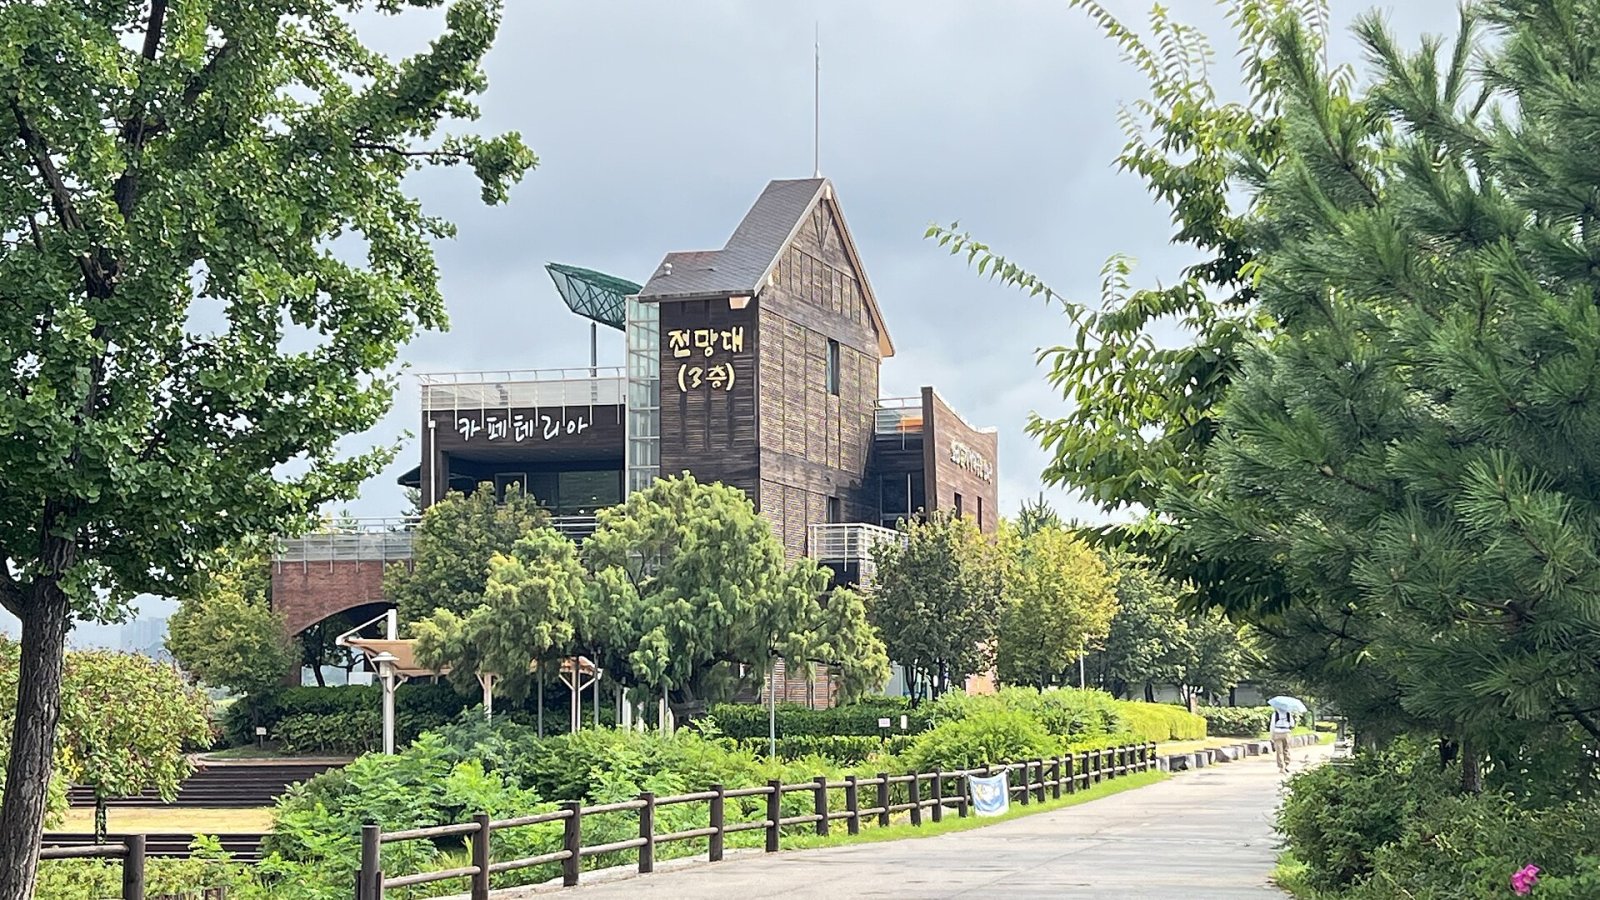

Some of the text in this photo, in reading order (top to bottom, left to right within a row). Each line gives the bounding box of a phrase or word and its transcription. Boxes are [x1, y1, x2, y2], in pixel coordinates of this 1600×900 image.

[667, 326, 744, 358] 전망대
[678, 362, 735, 392] (3층)
[458, 414, 589, 442] 카페테리아
